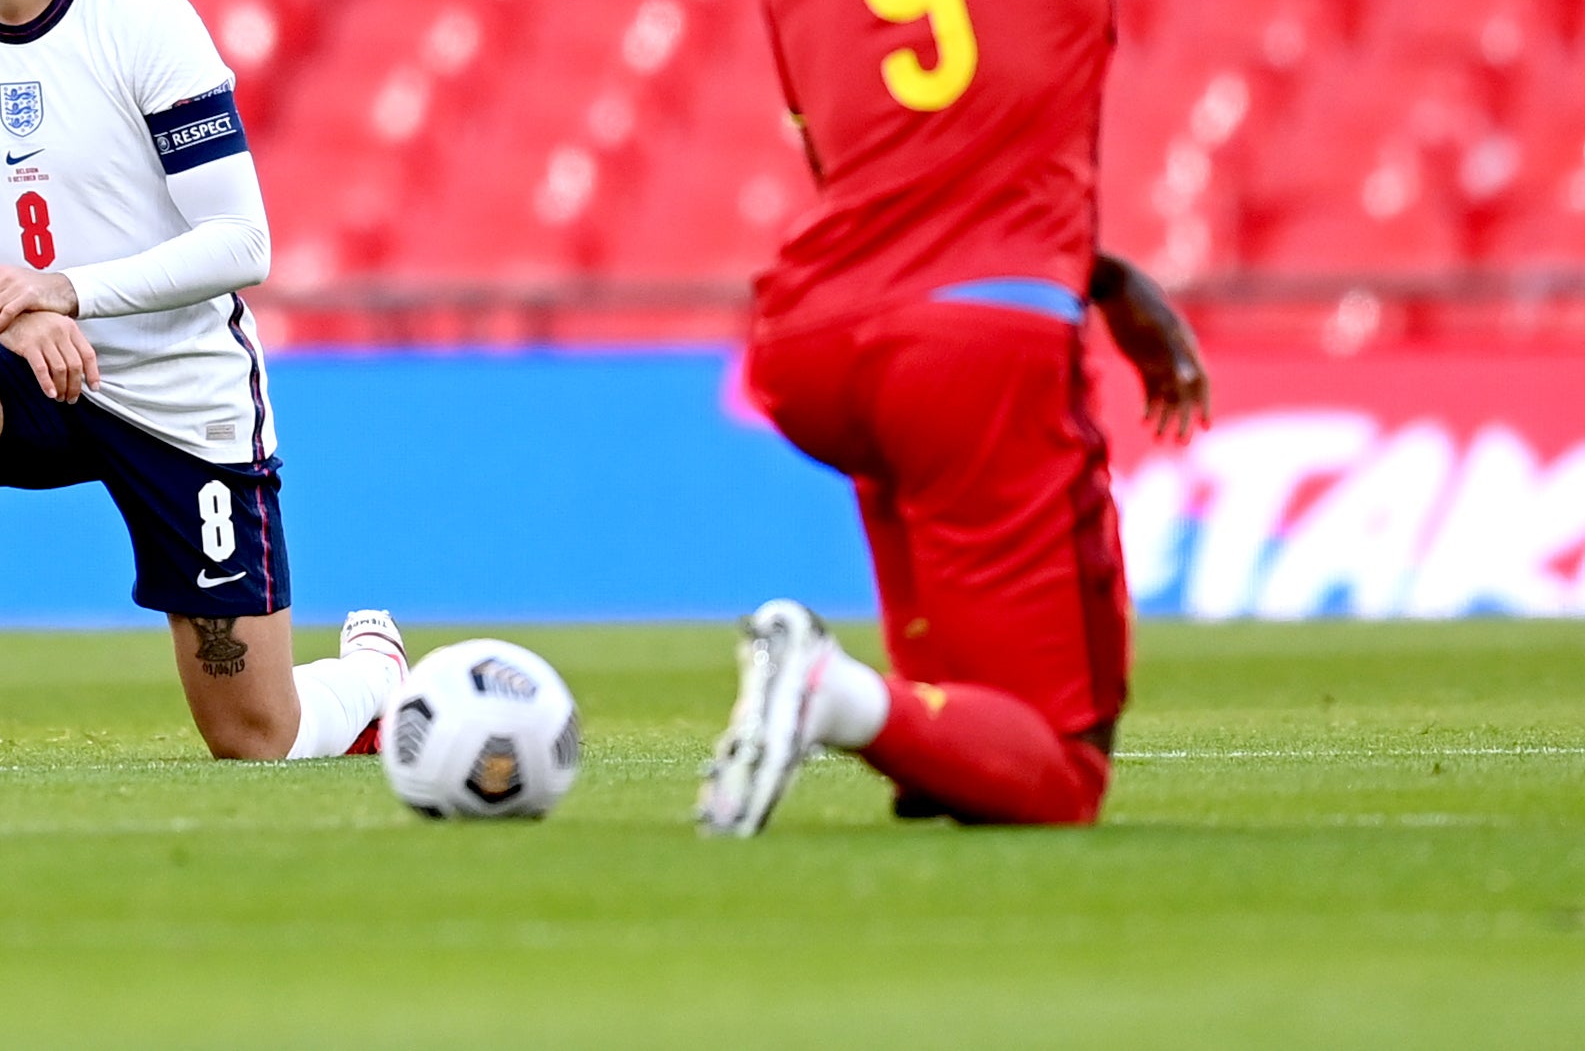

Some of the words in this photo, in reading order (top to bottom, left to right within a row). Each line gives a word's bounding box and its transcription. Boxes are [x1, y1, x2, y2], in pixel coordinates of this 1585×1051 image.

[171, 116, 232, 147] RESPECT
[16, 191, 55, 270] 8
[197, 479, 236, 563] 8
